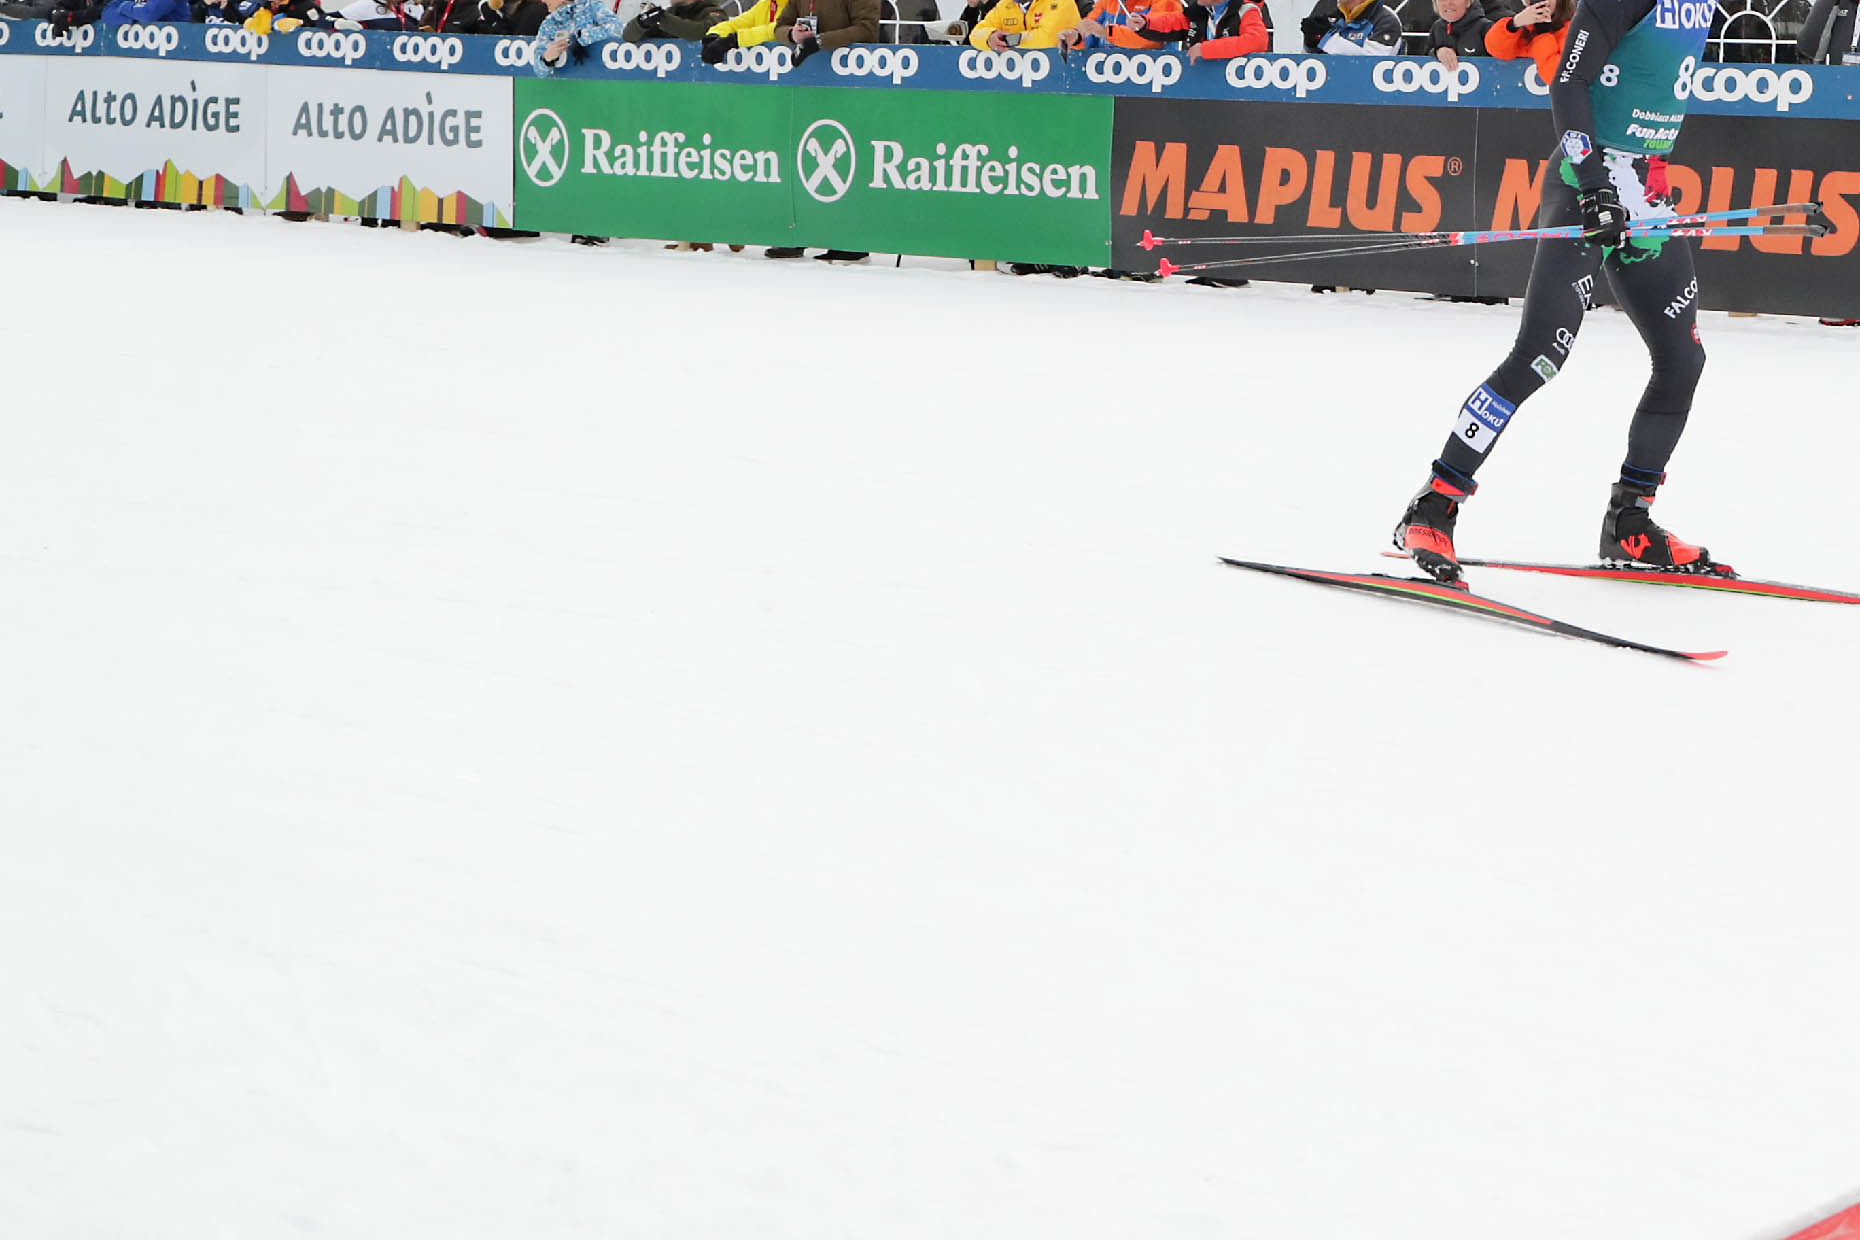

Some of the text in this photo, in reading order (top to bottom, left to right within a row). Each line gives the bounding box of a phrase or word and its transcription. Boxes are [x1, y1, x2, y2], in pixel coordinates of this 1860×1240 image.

[118, 24, 179, 56] coop
[205, 28, 269, 60] coop
[298, 32, 366, 64] coop
[393, 35, 463, 70] coop
[602, 42, 681, 78] coop
[713, 45, 794, 81] oop
[832, 48, 919, 85] coop
[959, 50, 1050, 88] coop
[1086, 53, 1182, 93] coop
[1226, 57, 1327, 98] coop
[1599, 64, 1620, 87] 8
[1673, 56, 1696, 100] 8
[1372, 60, 1480, 102] coop
[1692, 67, 1813, 112] coop
[581, 128, 781, 183] Raiffeisen
[868, 140, 1099, 200] Raiffeisen
[1663, 275, 1699, 319] FALCO
[1465, 422, 1480, 439] 8
